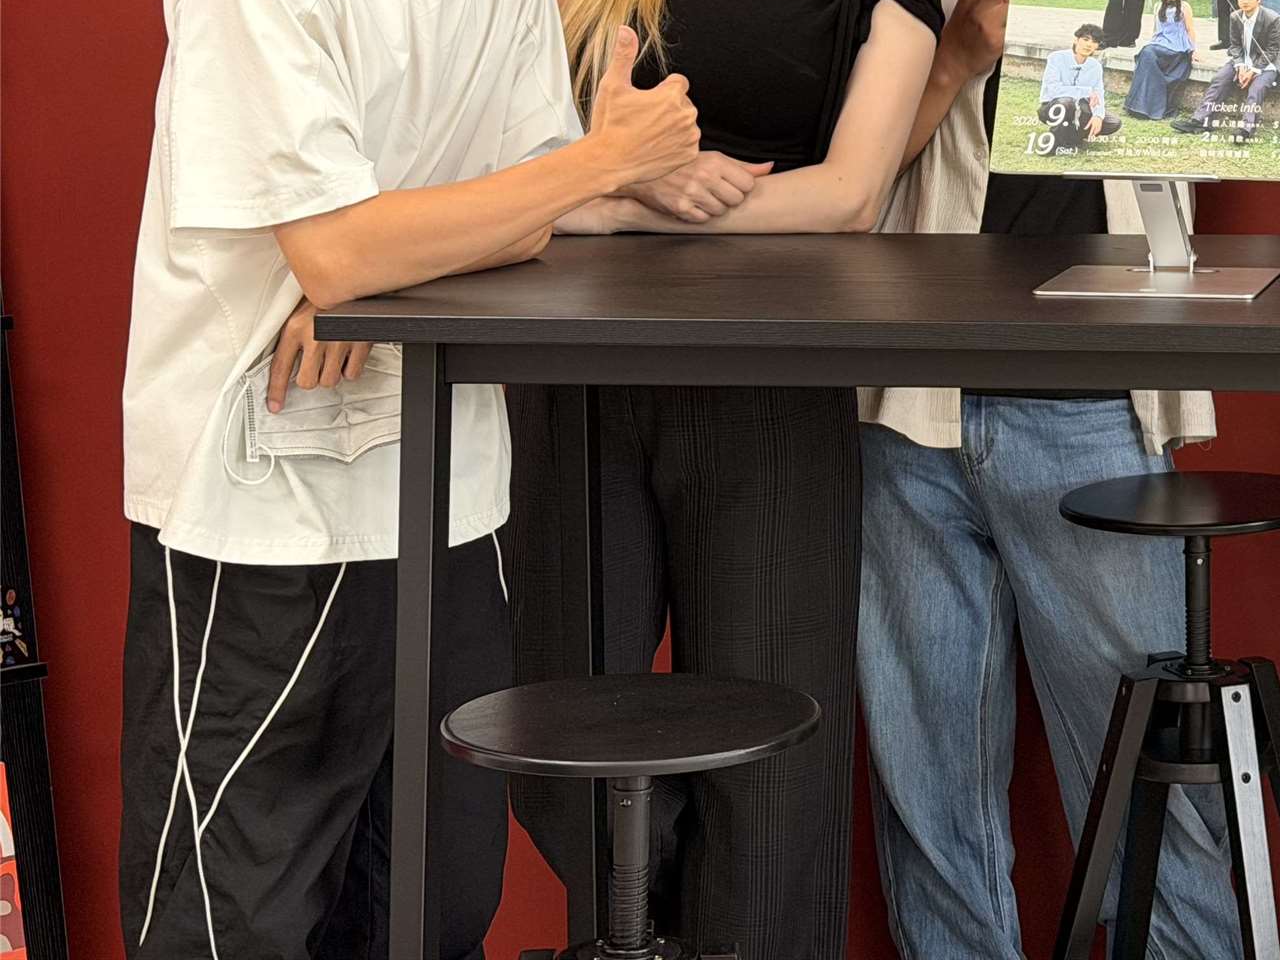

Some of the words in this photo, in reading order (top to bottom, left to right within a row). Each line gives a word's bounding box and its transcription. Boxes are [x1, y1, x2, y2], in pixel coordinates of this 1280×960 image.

[1046, 103, 1069, 127] 9.
[1205, 102, 1238, 113] Ticket
[1024, 131, 1055, 155] 19
